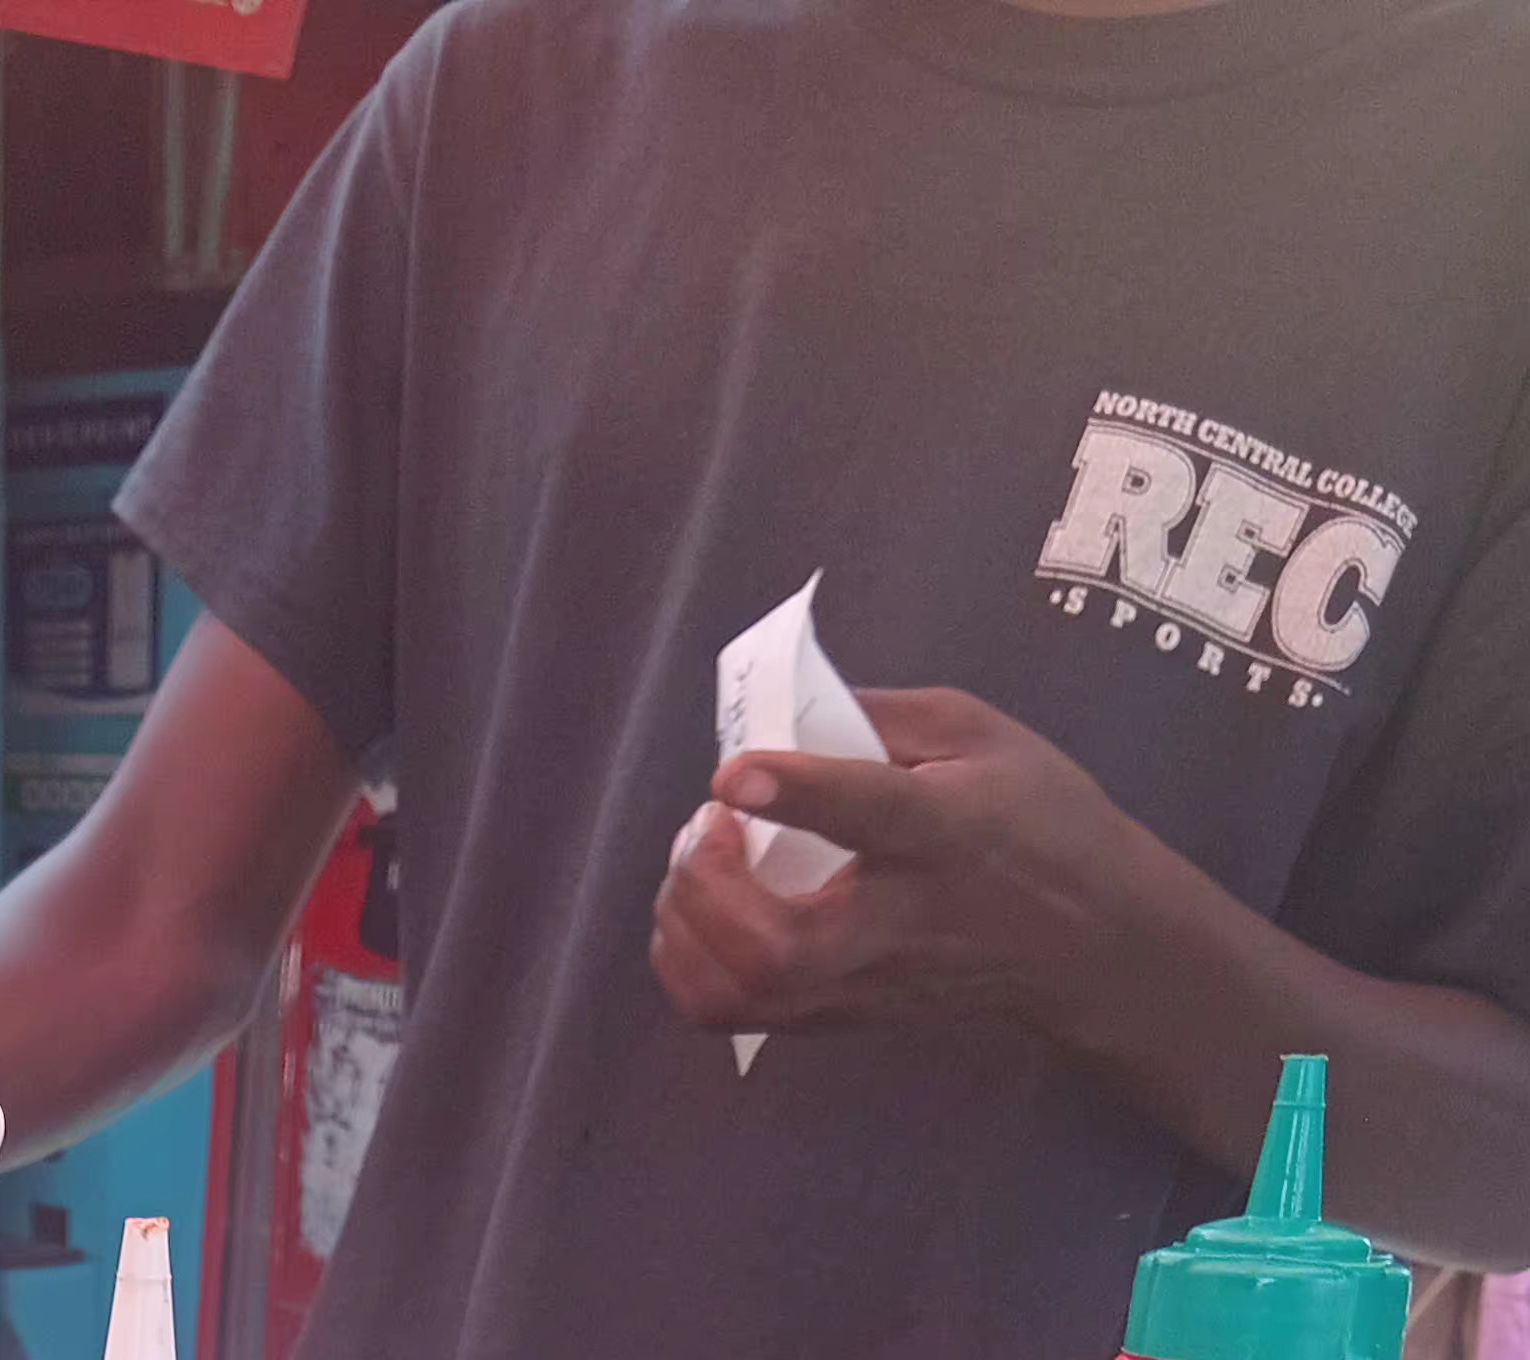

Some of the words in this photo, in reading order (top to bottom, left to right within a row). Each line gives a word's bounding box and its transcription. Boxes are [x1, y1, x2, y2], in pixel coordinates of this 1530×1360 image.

[1093, 389, 1197, 437] NORTH
[1197, 418, 1314, 490] CENTRAL
[1038, 422, 1406, 674] REC
